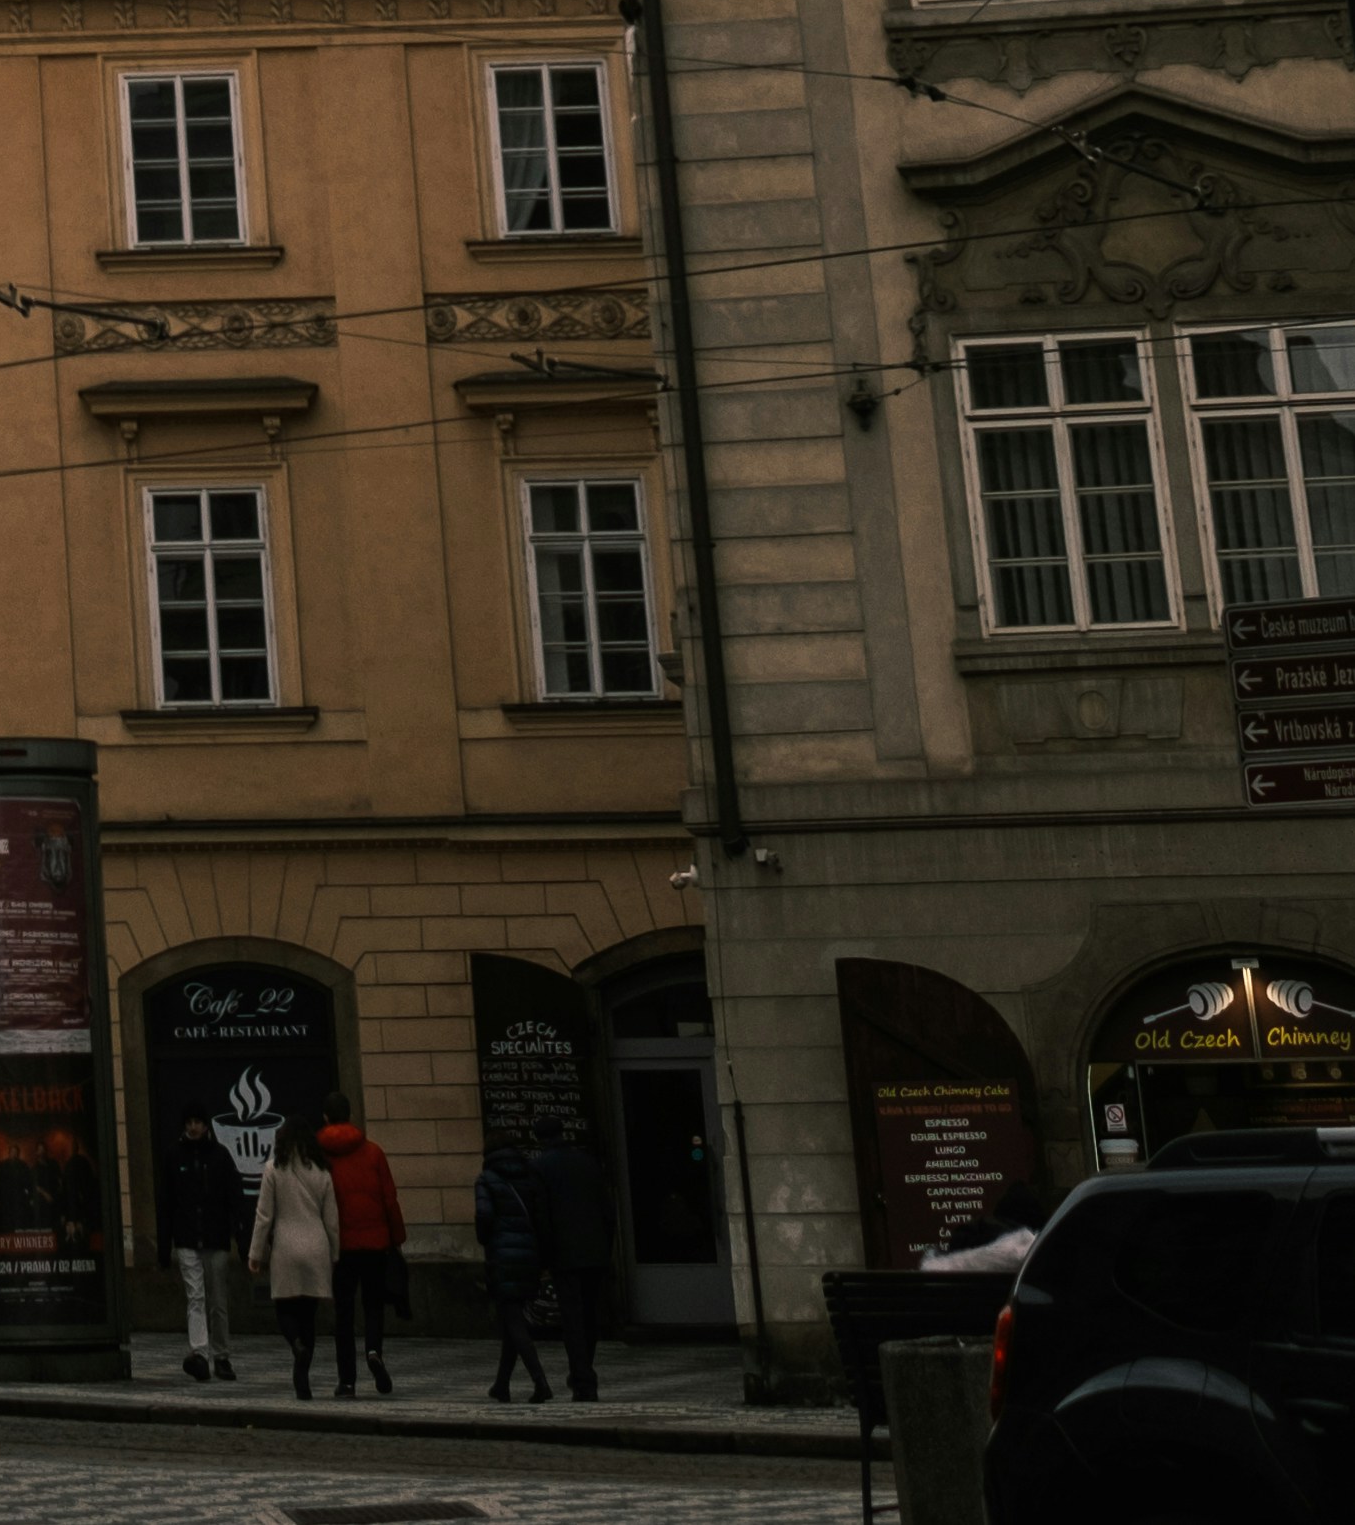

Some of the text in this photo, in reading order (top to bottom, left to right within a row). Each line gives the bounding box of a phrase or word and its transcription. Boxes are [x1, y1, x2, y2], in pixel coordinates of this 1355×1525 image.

[1260, 612, 1295, 638] České
[1298, 616, 1348, 635] muzeum
[1276, 663, 1327, 689] Pražské
[1274, 716, 1342, 742] Vrtbovská
[174, 1023, 209, 1039] CAFÉ
[220, 1024, 309, 1039] RESTAURANT
[506, 1020, 557, 1039] CZECH
[1134, 1026, 1352, 1051] Old Czech Chimney
[877, 1084, 1011, 1098] Old Czech Chimney Cake
[924, 1118, 970, 1128] ESPRESSO
[910, 1131, 987, 1142] DOUBL ESPRESSO
[235, 1131, 271, 1164] illy
[934, 1145, 966, 1155] LUNGO
[925, 1159, 979, 1168] AMERICANO
[904, 1172, 1003, 1183] ESPRESSO MACCHIATO
[926, 1186, 984, 1196] CAPPUCCINO
[930, 1200, 983, 1210] FLAT WHITE
[14, 1235, 55, 1250] WINNERS
[20, 1259, 52, 1274] PRAHA
[72, 1258, 96, 1273] ARENA
